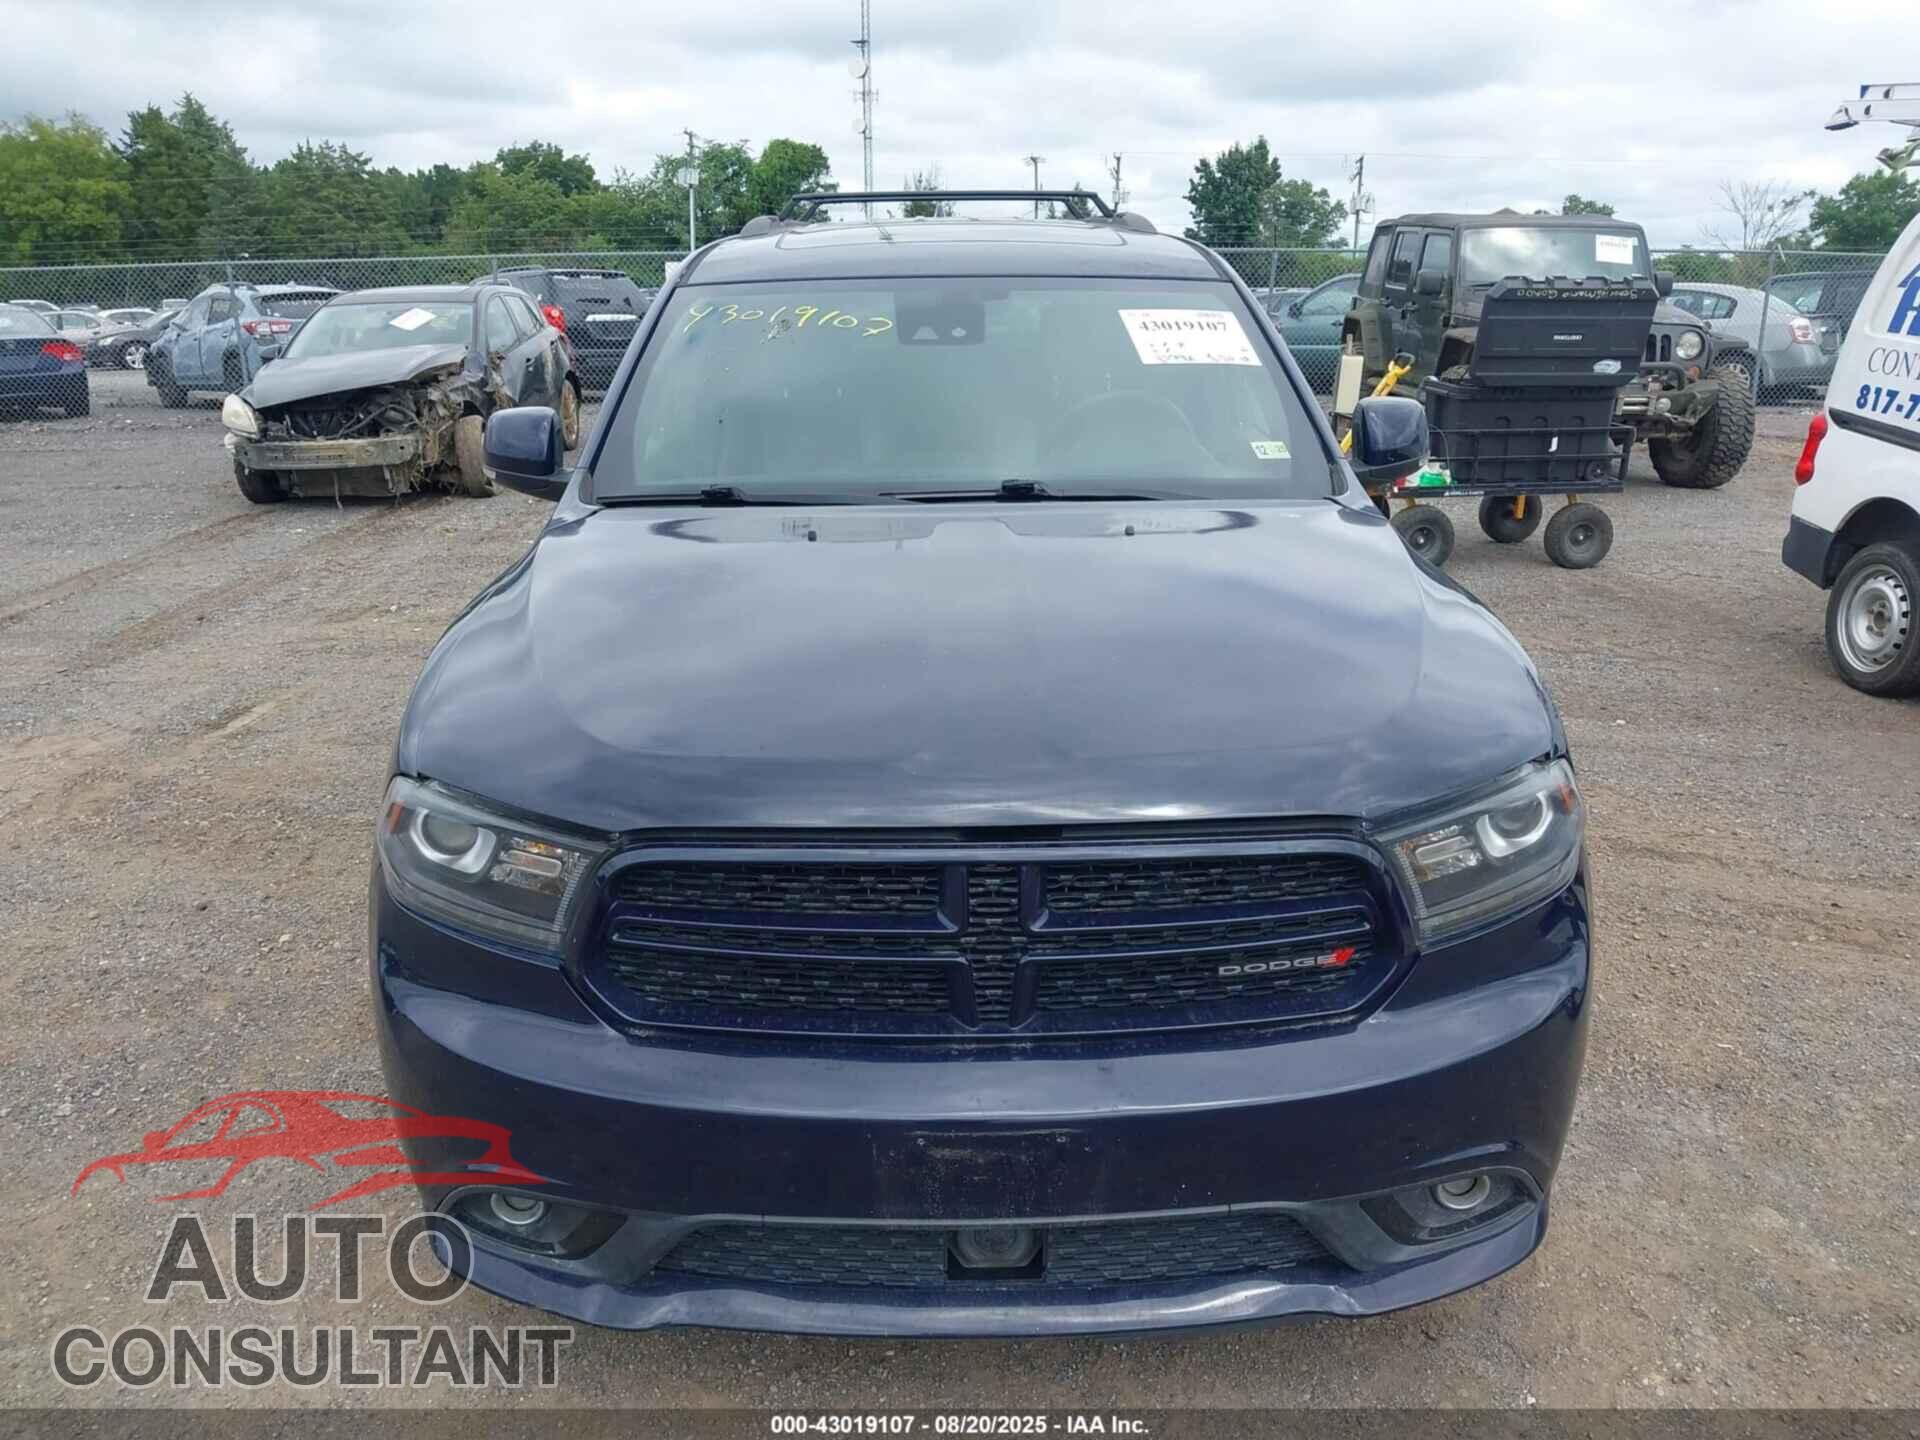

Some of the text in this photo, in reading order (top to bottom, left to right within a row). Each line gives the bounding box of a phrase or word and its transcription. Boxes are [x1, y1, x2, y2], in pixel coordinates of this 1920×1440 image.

[1139, 319, 1227, 333] 43019107
[1867, 346, 1920, 381] CON
[1855, 383, 1920, 422] 817-7
[1218, 953, 1337, 976] DODGE
